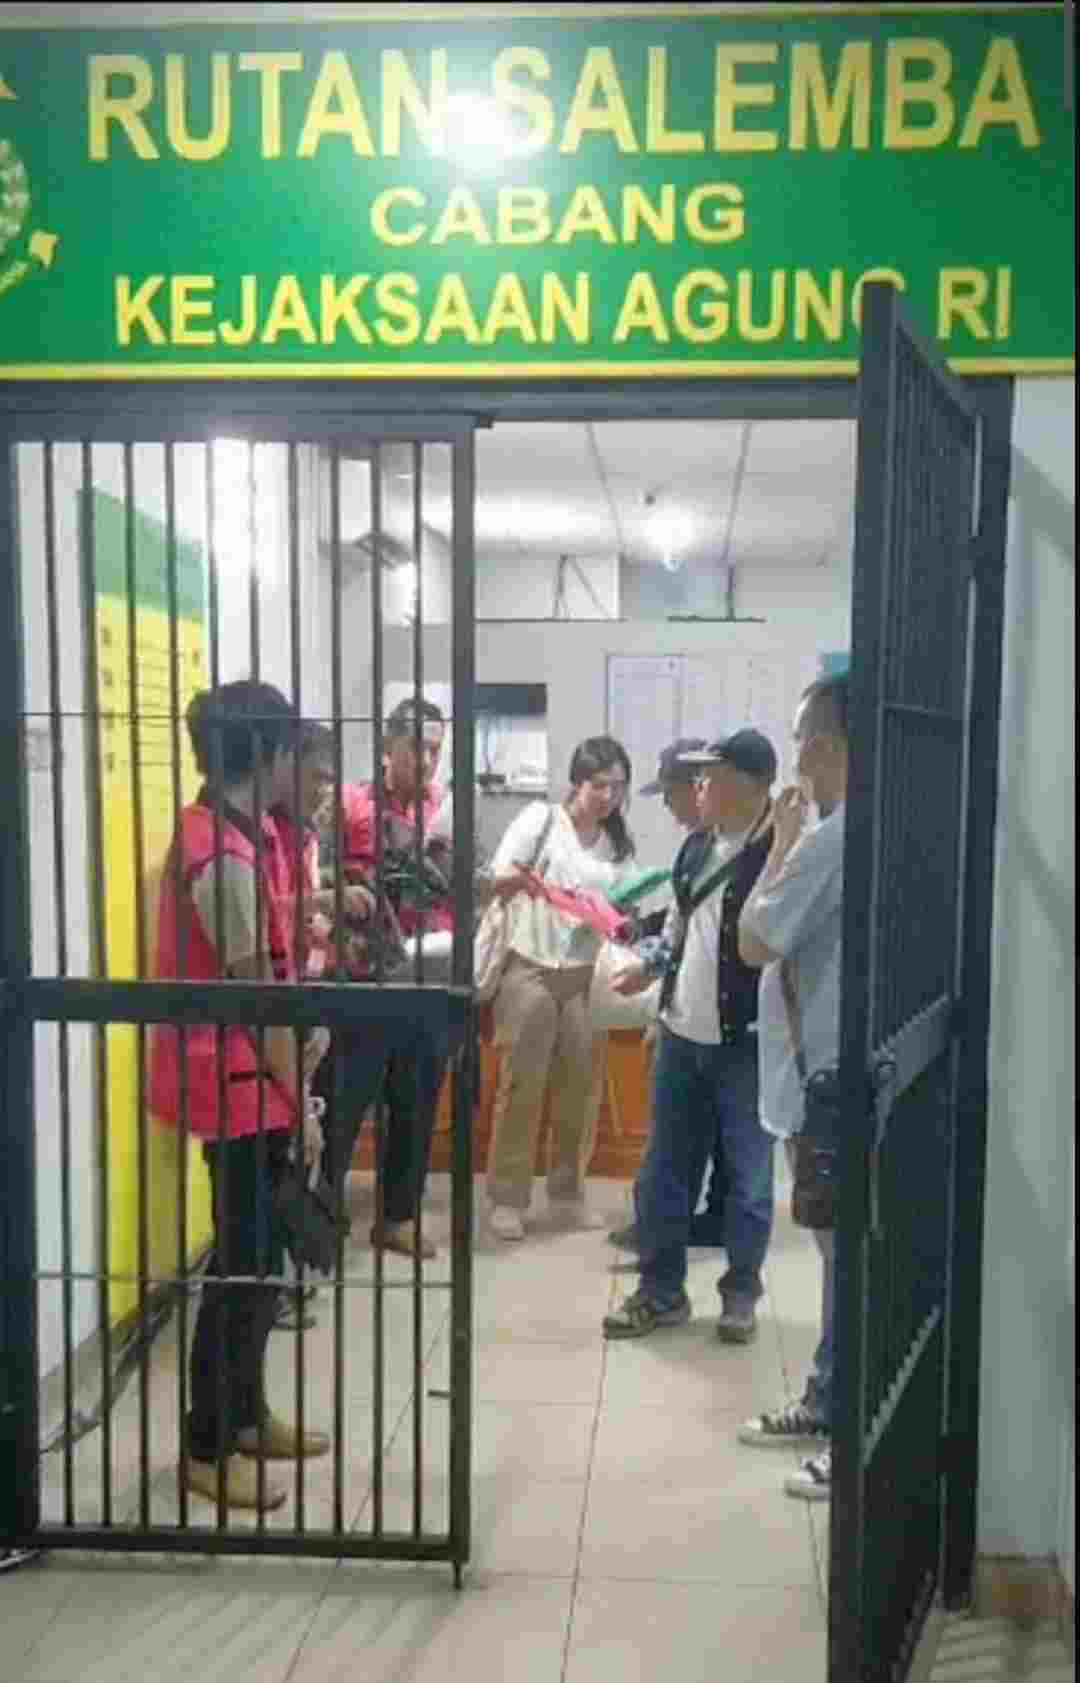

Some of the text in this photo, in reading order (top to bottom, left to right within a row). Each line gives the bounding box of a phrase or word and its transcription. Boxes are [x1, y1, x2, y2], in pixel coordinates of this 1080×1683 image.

[88, 37, 1041, 161] RUTAN SALEMBA
[370, 182, 746, 247] CABANG
[115, 272, 590, 346] KEJAKSAAN
[938, 267, 1012, 340] RI
